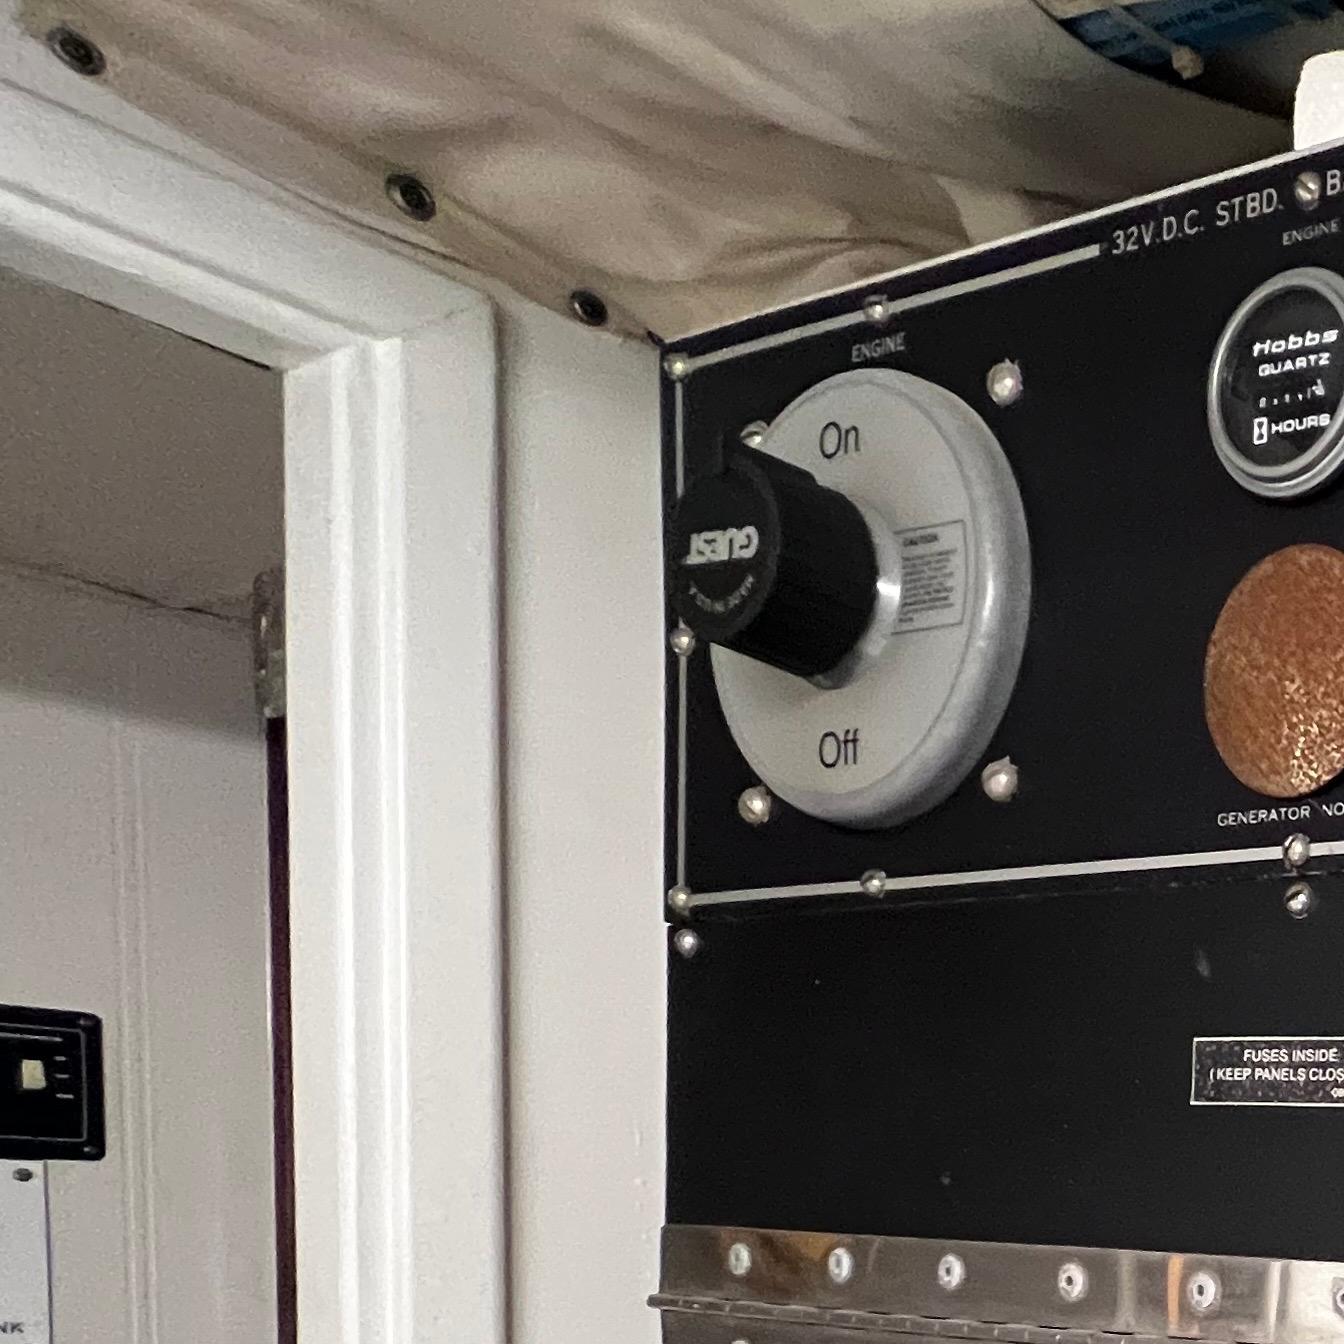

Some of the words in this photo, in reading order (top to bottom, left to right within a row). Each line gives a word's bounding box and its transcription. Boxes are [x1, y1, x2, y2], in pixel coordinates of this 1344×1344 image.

[1215, 188, 1284, 226] STBD.
[1282, 218, 1341, 246] ENGINE
[851, 331, 906, 362] ENGINE
[1253, 329, 1339, 357] Hobbs
[1258, 352, 1331, 376] QUARTZ
[1271, 413, 1331, 434] HOURS
[820, 421, 860, 459] On
[818, 727, 859, 769] Off
[1217, 805, 1311, 827] GENERATOR
[1243, 1048, 1288, 1062] FUSES
[1292, 1048, 1338, 1062] INSIDE
[1254, 1067, 1306, 1082] PANELS
